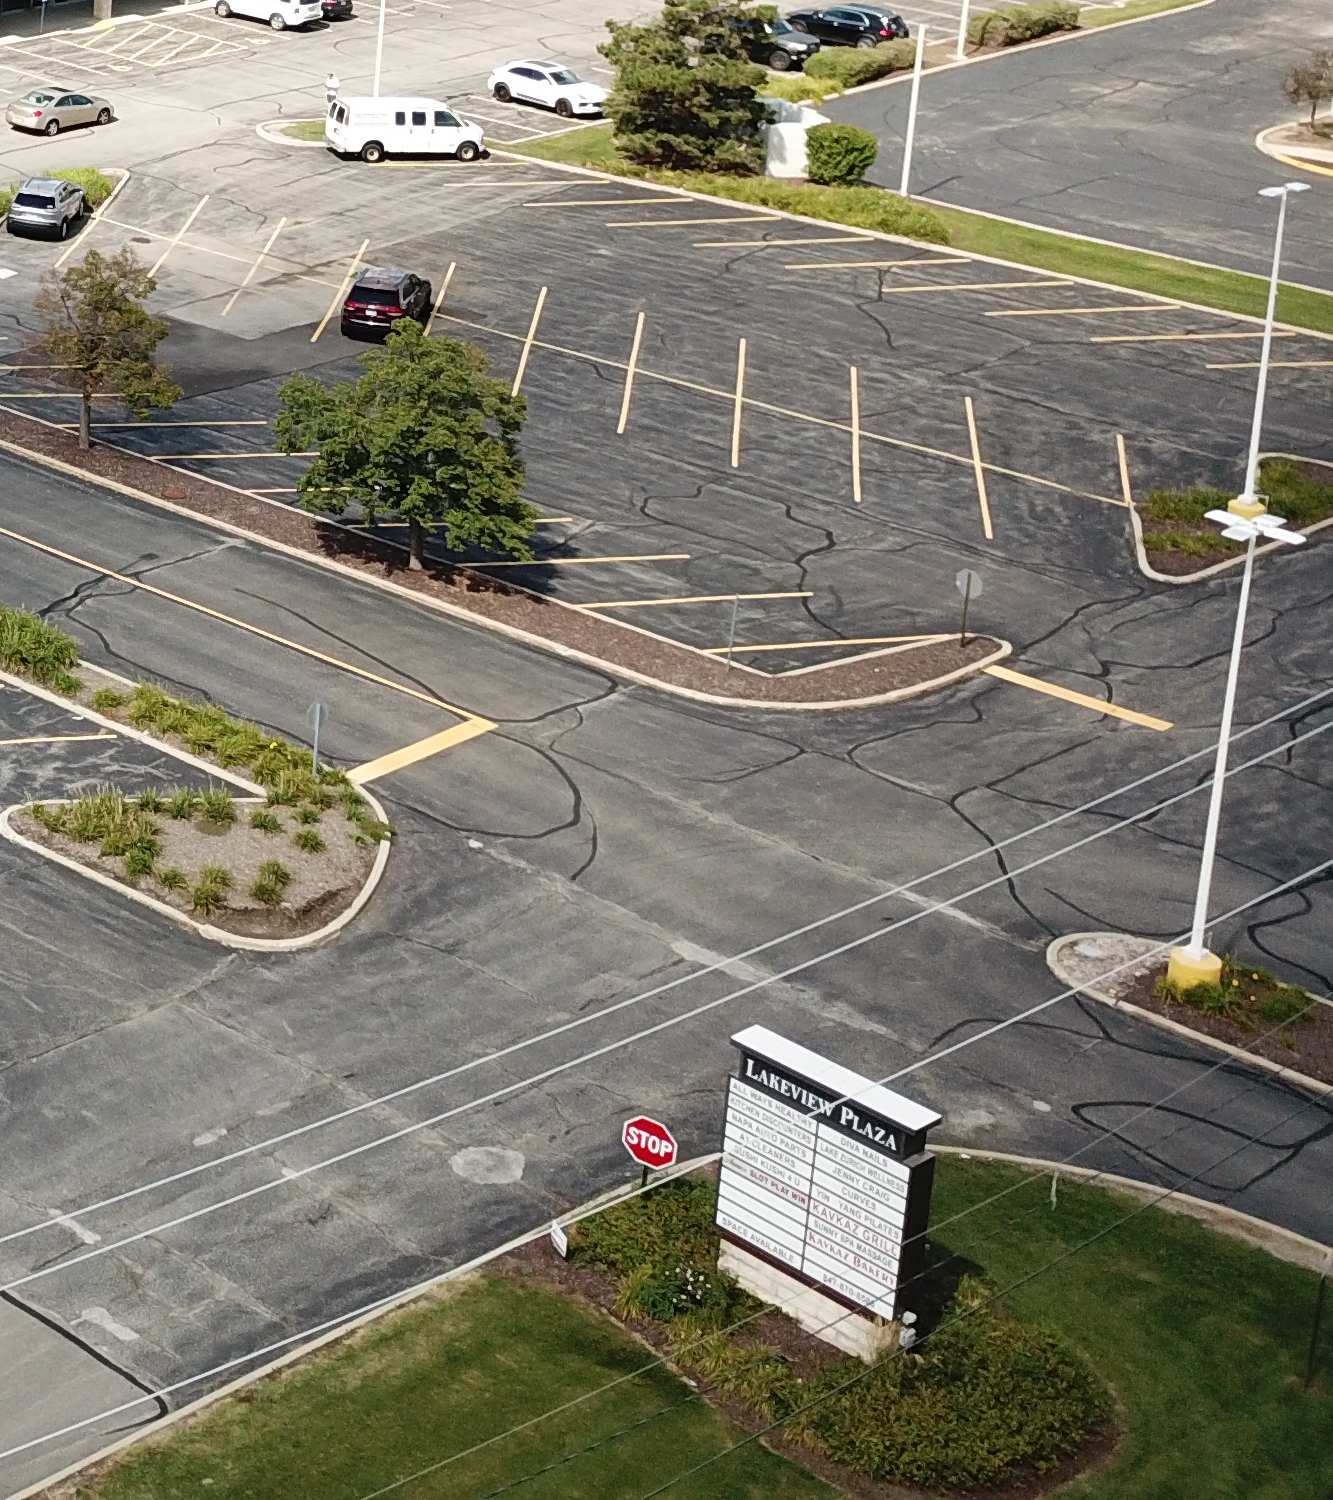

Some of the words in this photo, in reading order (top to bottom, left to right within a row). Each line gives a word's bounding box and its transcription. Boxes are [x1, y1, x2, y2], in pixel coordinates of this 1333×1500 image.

[730, 1096, 760, 1120] KITCHEN
[762, 1112, 812, 1145] DISCOUNTERS
[733, 1082, 748, 1096] ALL
[750, 1092, 773, 1109] WAYS
[775, 1103, 813, 1128] HEALTHY
[745, 1058, 835, 1117] LAKEVIEW
[839, 1106, 897, 1151] PLAZA
[626, 1126, 673, 1157] STOP
[731, 1112, 754, 1130] NAPA
[779, 1138, 807, 1158] PARTS
[752, 1140, 796, 1168] CLEANERS
[840, 1137, 860, 1153] DIVA
[862, 1151, 888, 1167] NAILS
[733, 1145, 759, 1164] SUSHI
[760, 1160, 785, 1179] KUSHI
[820, 1143, 838, 1158] LAKE
[840, 1153, 866, 1173] ZURICH
[867, 1168, 905, 1193] WELLNESS
[833, 1166, 860, 1186] JENNY
[862, 1181, 890, 1201] CRAIG
[749, 1169, 768, 1183] SLOT
[770, 1181, 789, 1195] PLAY
[791, 1191, 806, 1204] WIN
[841, 1186, 876, 1211] CURVES
[813, 1201, 860, 1235] KAVKAZ
[862, 1229, 898, 1257] GRILL
[816, 1188, 830, 1202] YIN
[838, 1200, 862, 1219] YANG
[864, 1213, 899, 1239] PILATES
[722, 1217, 749, 1237] SPACE
[750, 1233, 795, 1263] AVAILABLE
[809, 1231, 849, 1261] KAVKAZ
[853, 1255, 894, 1286] BAKERY
[813, 1220, 839, 1239] SUNNY
[856, 1242, 893, 1269] MASSAGE
